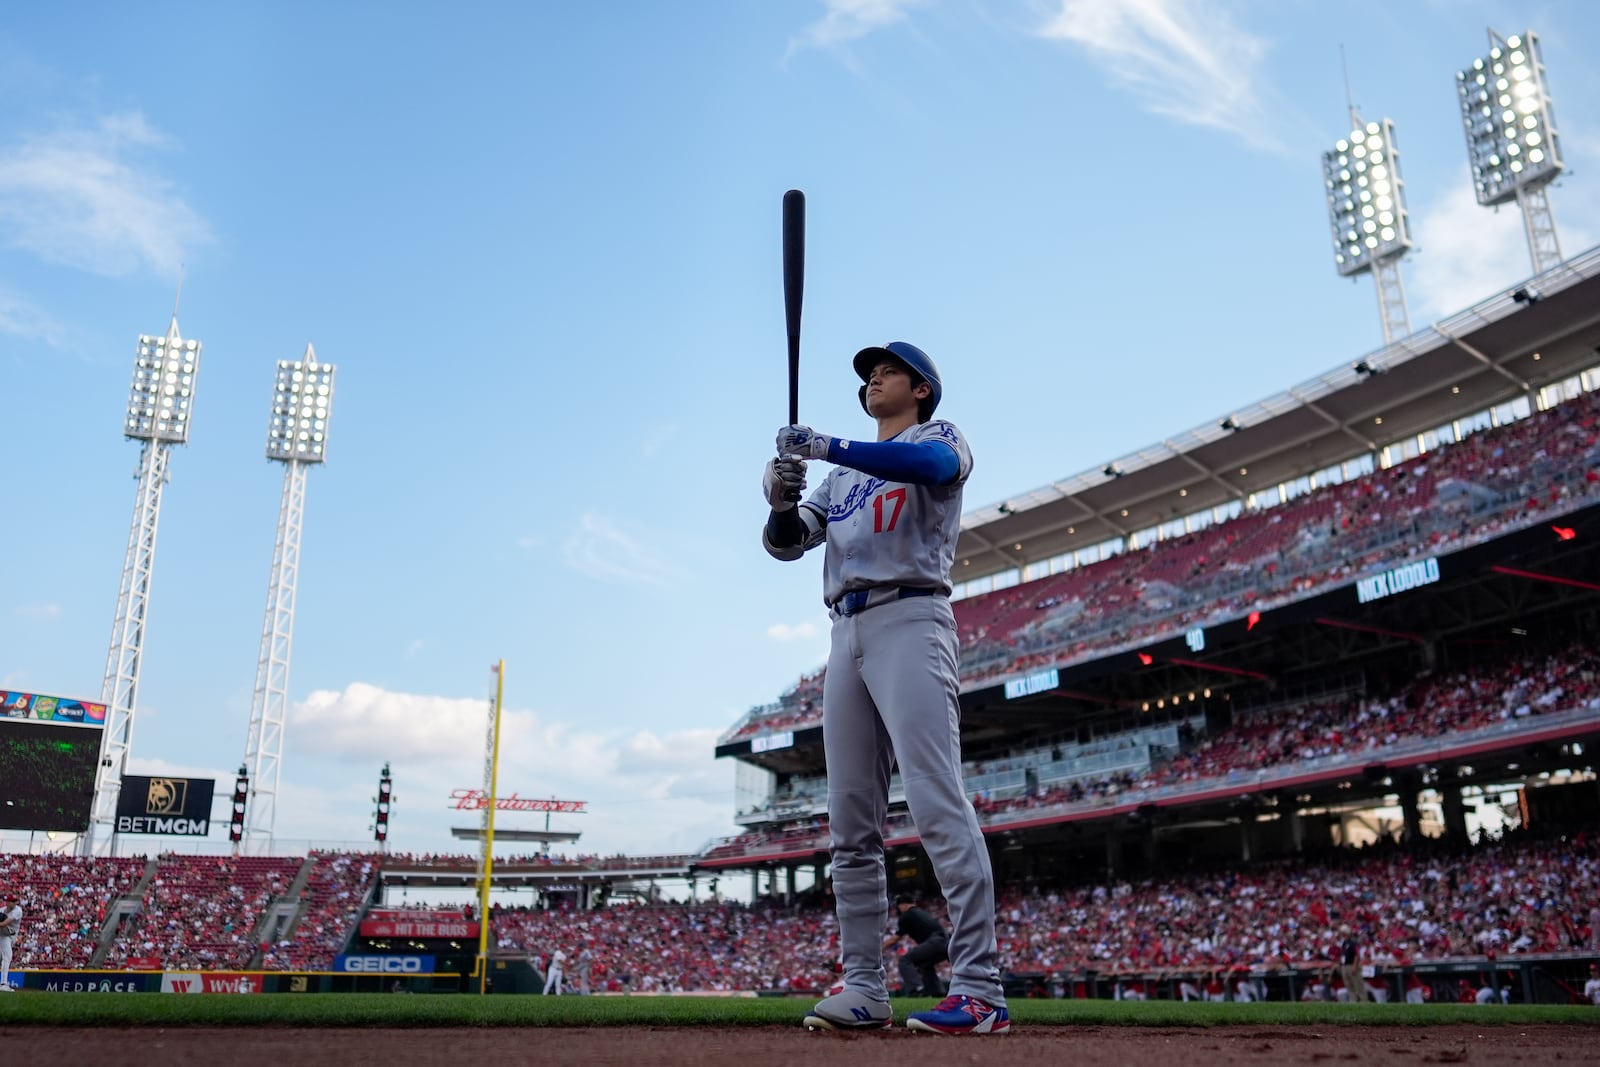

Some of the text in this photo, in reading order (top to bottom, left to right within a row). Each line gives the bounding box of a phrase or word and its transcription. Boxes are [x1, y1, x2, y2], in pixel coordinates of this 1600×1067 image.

[872, 487, 906, 533] 17
[1356, 557, 1440, 604] NICK LODOLO
[118, 816, 207, 835] BETMGM
[395, 923, 414, 935] HIT
[416, 923, 436, 936] THE
[344, 956, 421, 972] GEICO
[46, 978, 137, 993] MEDPACE
[209, 978, 256, 993] Wylr
[850, 1006, 872, 1021] N
